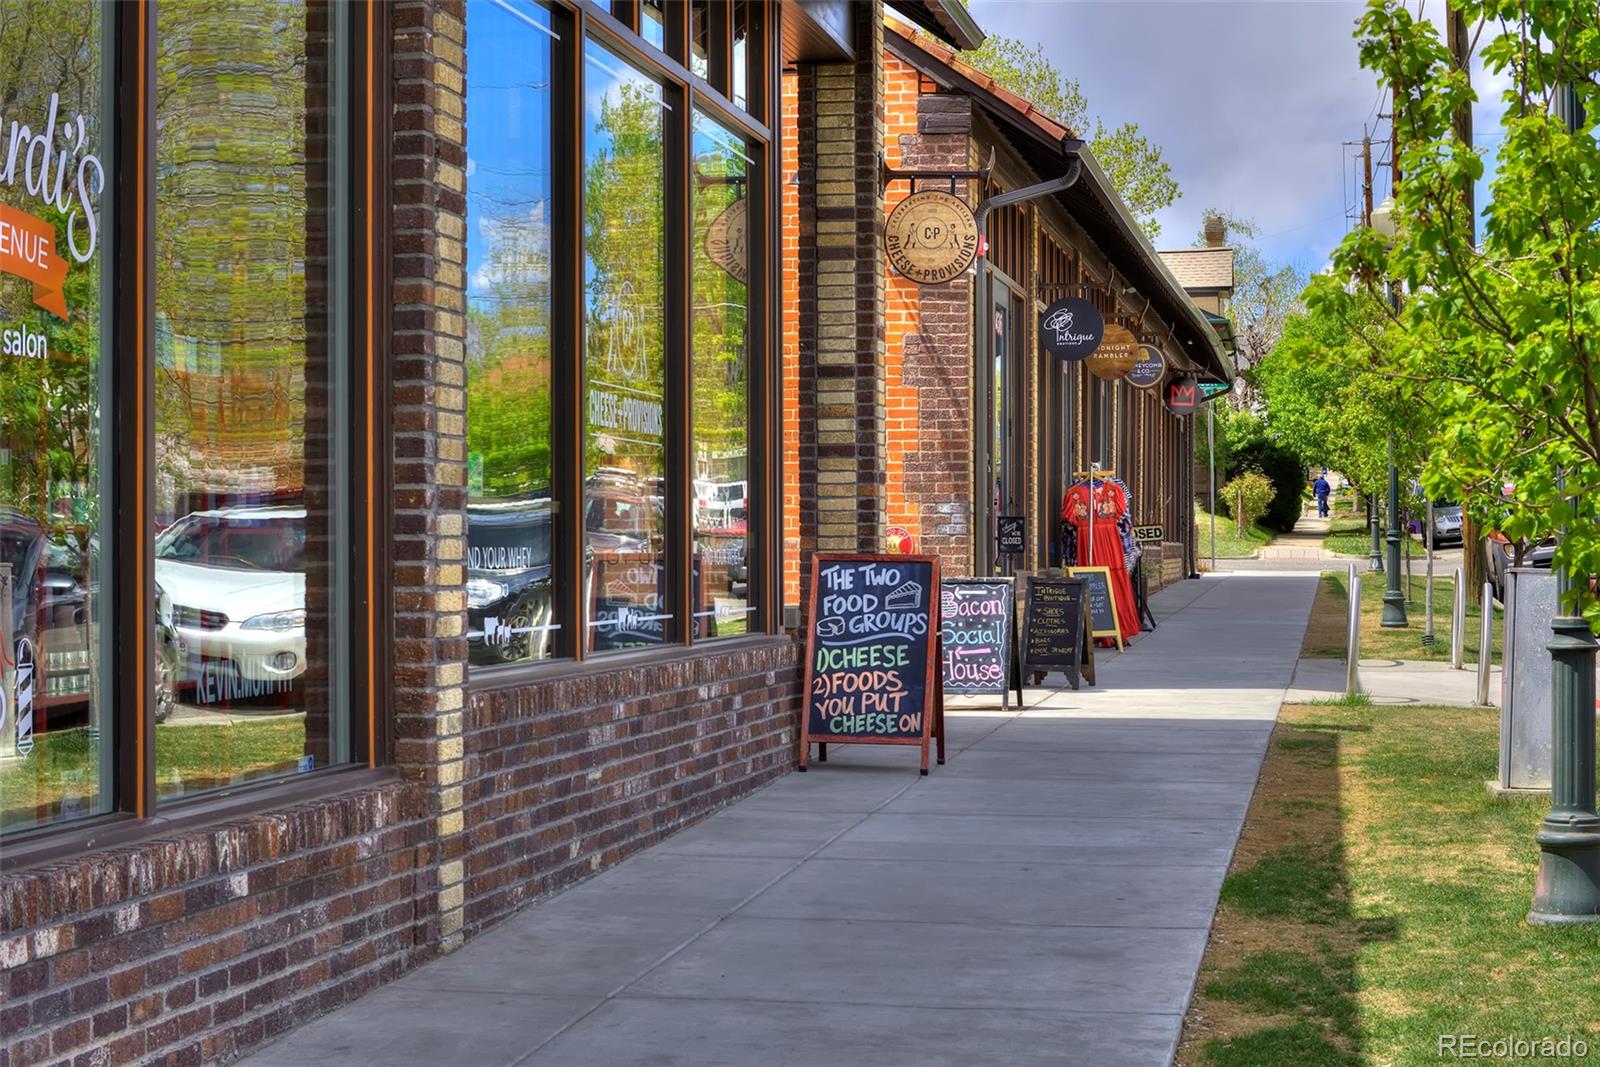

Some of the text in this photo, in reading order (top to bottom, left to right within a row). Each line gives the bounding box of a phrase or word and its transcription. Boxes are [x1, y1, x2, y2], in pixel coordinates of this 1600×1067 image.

[0, 92, 105, 263] rdi's
[3, 323, 48, 360] salon
[482, 547, 506, 569] YOUR
[507, 546, 532, 569] WHEY
[820, 563, 900, 590] THE TWO
[823, 594, 878, 616] FOOD
[942, 591, 1004, 618] Bacon
[1043, 607, 1065, 616] SHOES
[848, 611, 928, 635] GROUPS
[942, 621, 1002, 644] Social
[815, 690, 909, 720] YOU PUT
[830, 712, 921, 734] CHEESE ON
